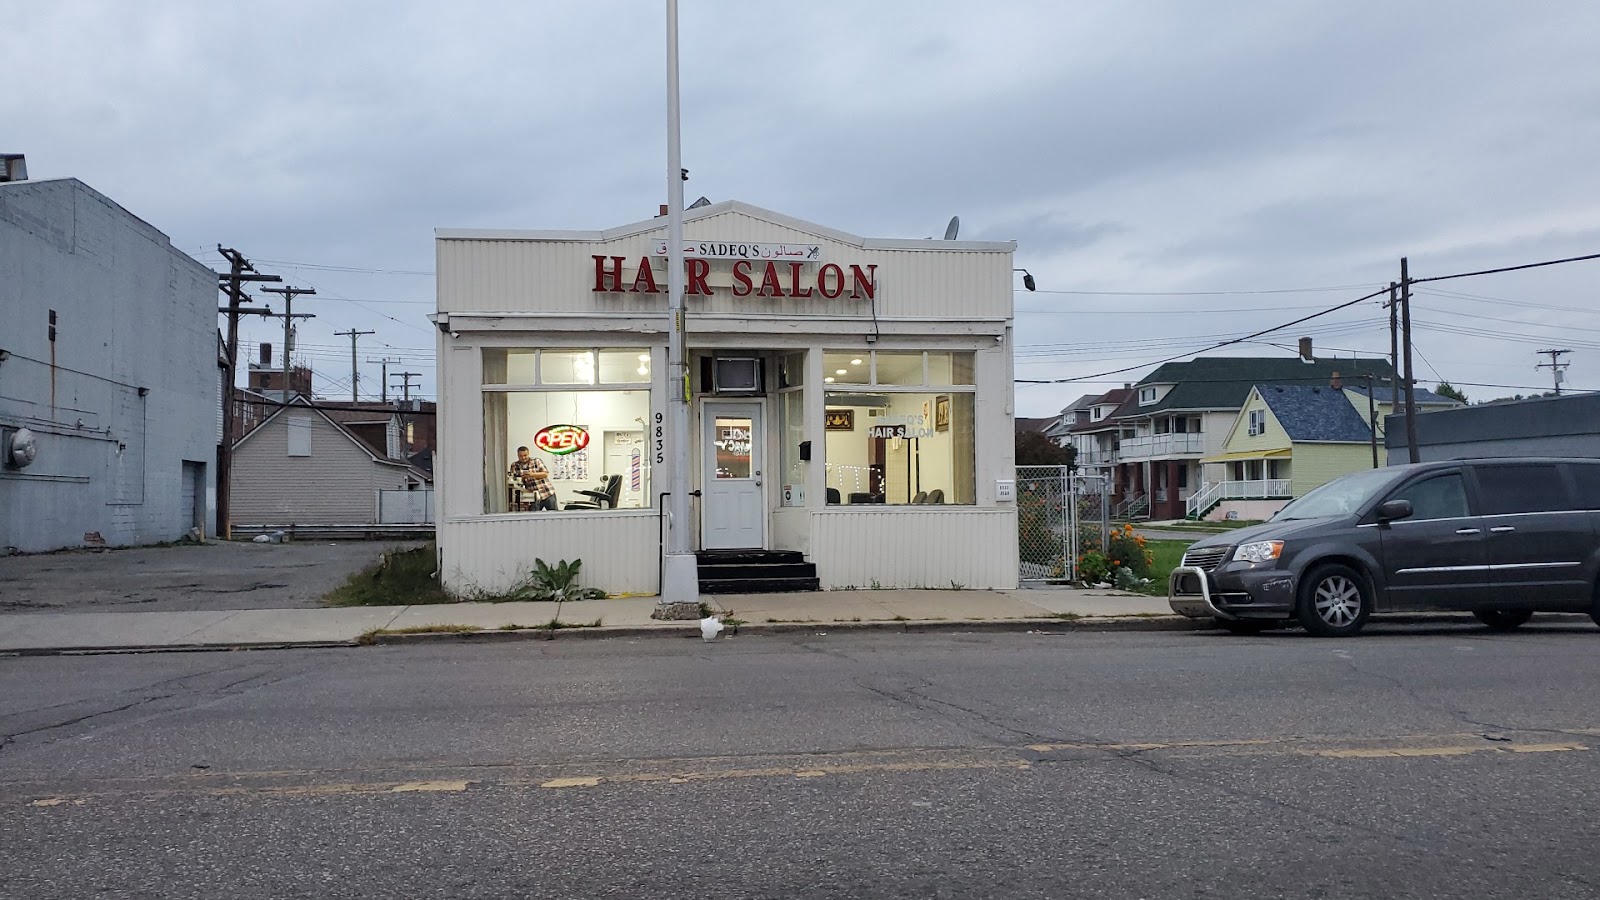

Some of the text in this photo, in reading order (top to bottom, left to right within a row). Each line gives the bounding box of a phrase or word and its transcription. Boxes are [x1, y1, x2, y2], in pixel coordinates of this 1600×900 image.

[699, 242, 760, 258] SADEQ'S
[761, 245, 804, 259] صالون
[591, 254, 878, 299] HAR SALON
[536, 430, 586, 448] OPEN
[655, 412, 664, 464] 9835
[868, 427, 934, 439] HAIR SALON
